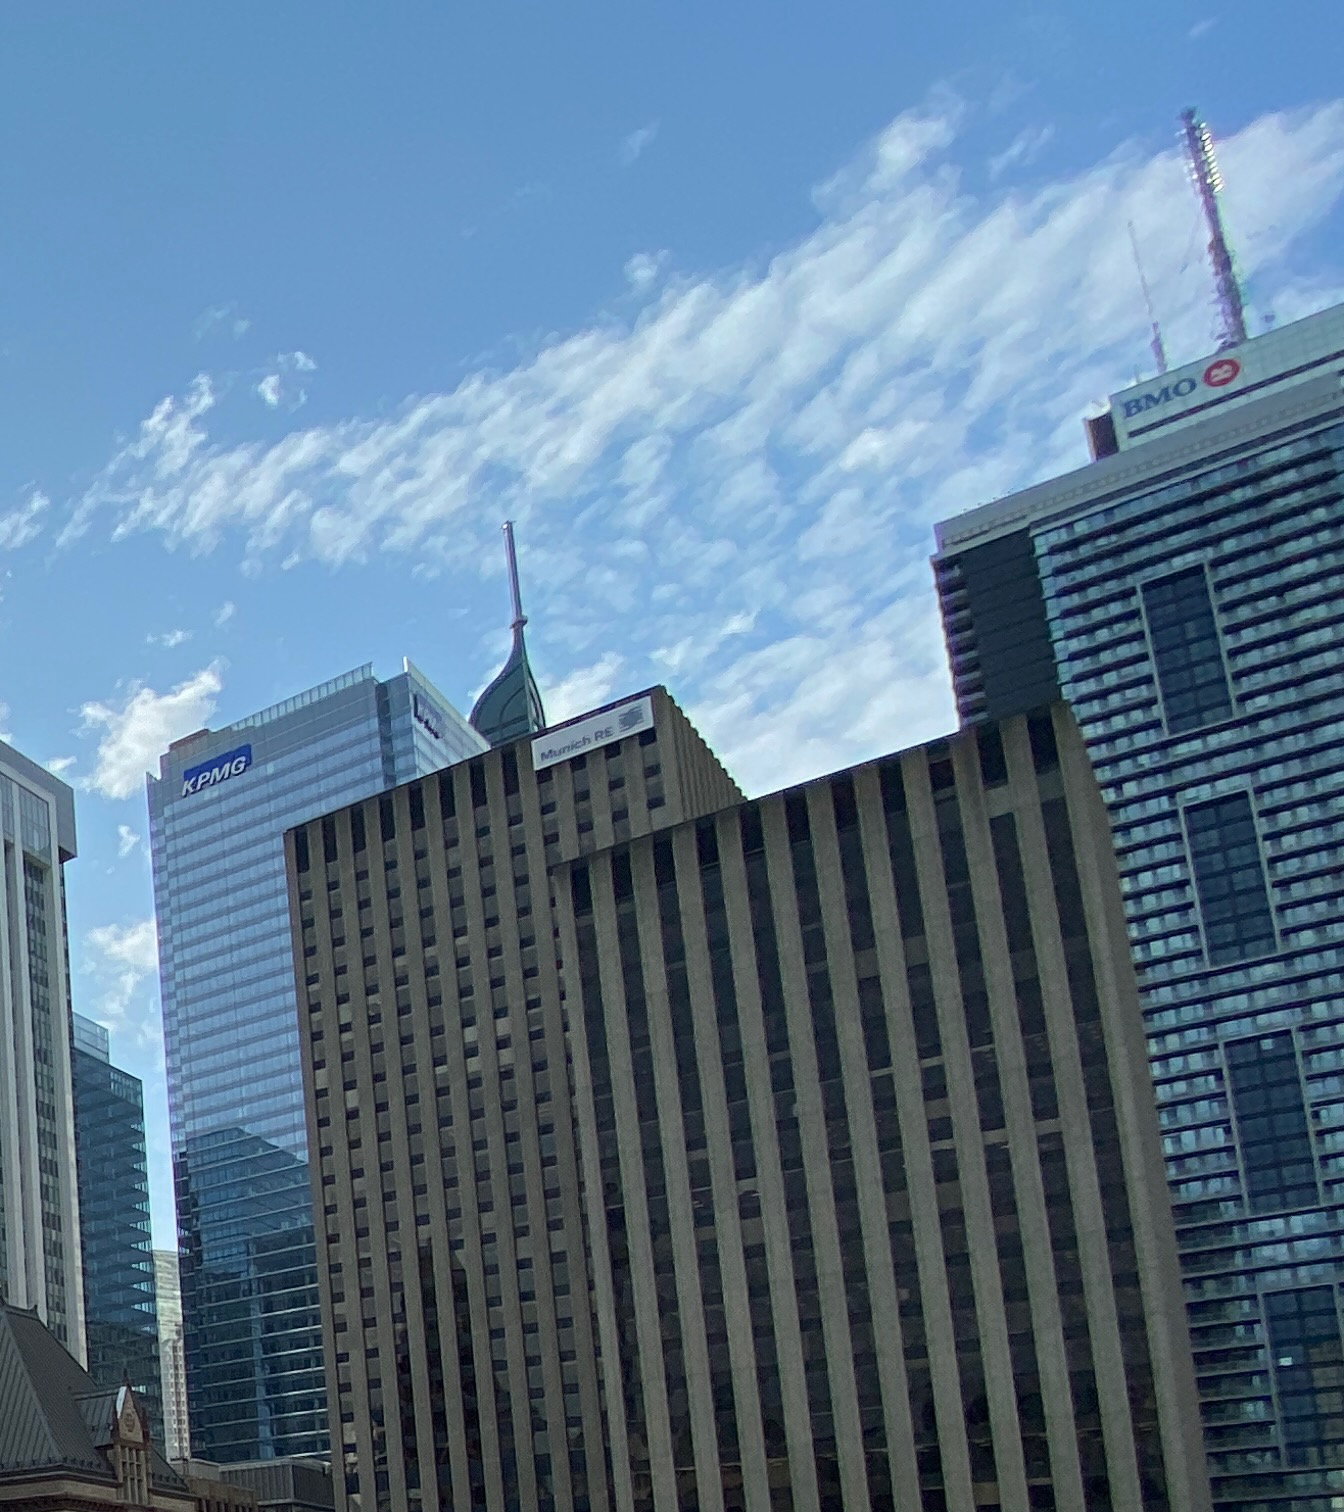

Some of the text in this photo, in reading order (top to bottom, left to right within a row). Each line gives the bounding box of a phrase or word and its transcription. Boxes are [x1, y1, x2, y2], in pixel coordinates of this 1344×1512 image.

[1123, 377, 1198, 420] BMO
[540, 726, 614, 762] Munich RE
[181, 755, 247, 798] KPMG
